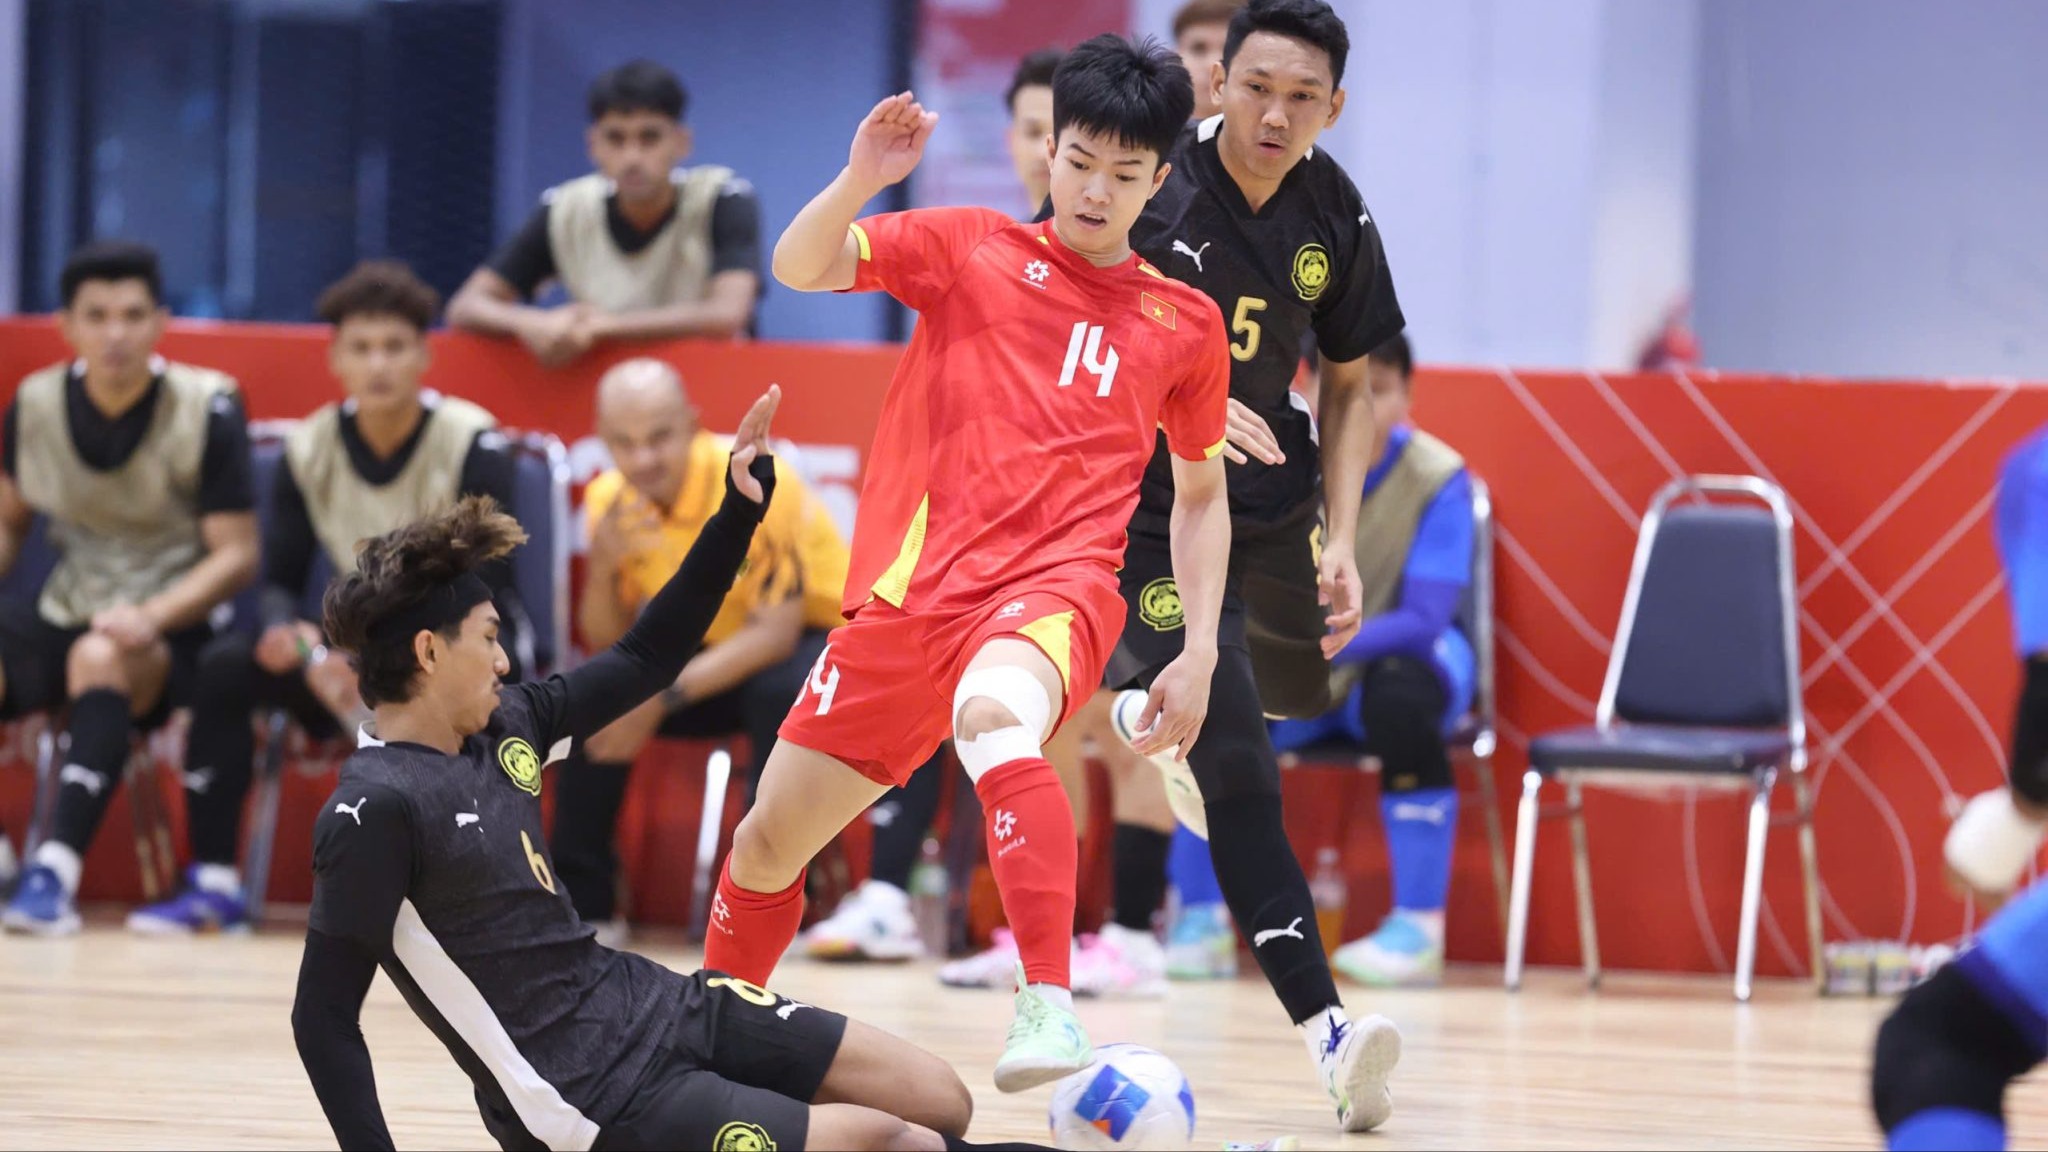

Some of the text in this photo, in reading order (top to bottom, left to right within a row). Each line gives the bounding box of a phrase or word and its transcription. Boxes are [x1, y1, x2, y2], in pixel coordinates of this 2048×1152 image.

[1057, 320, 1120, 397] 14
[1229, 295, 1268, 362] 5
[520, 829, 558, 895] 6
[706, 977, 777, 1006] 6
